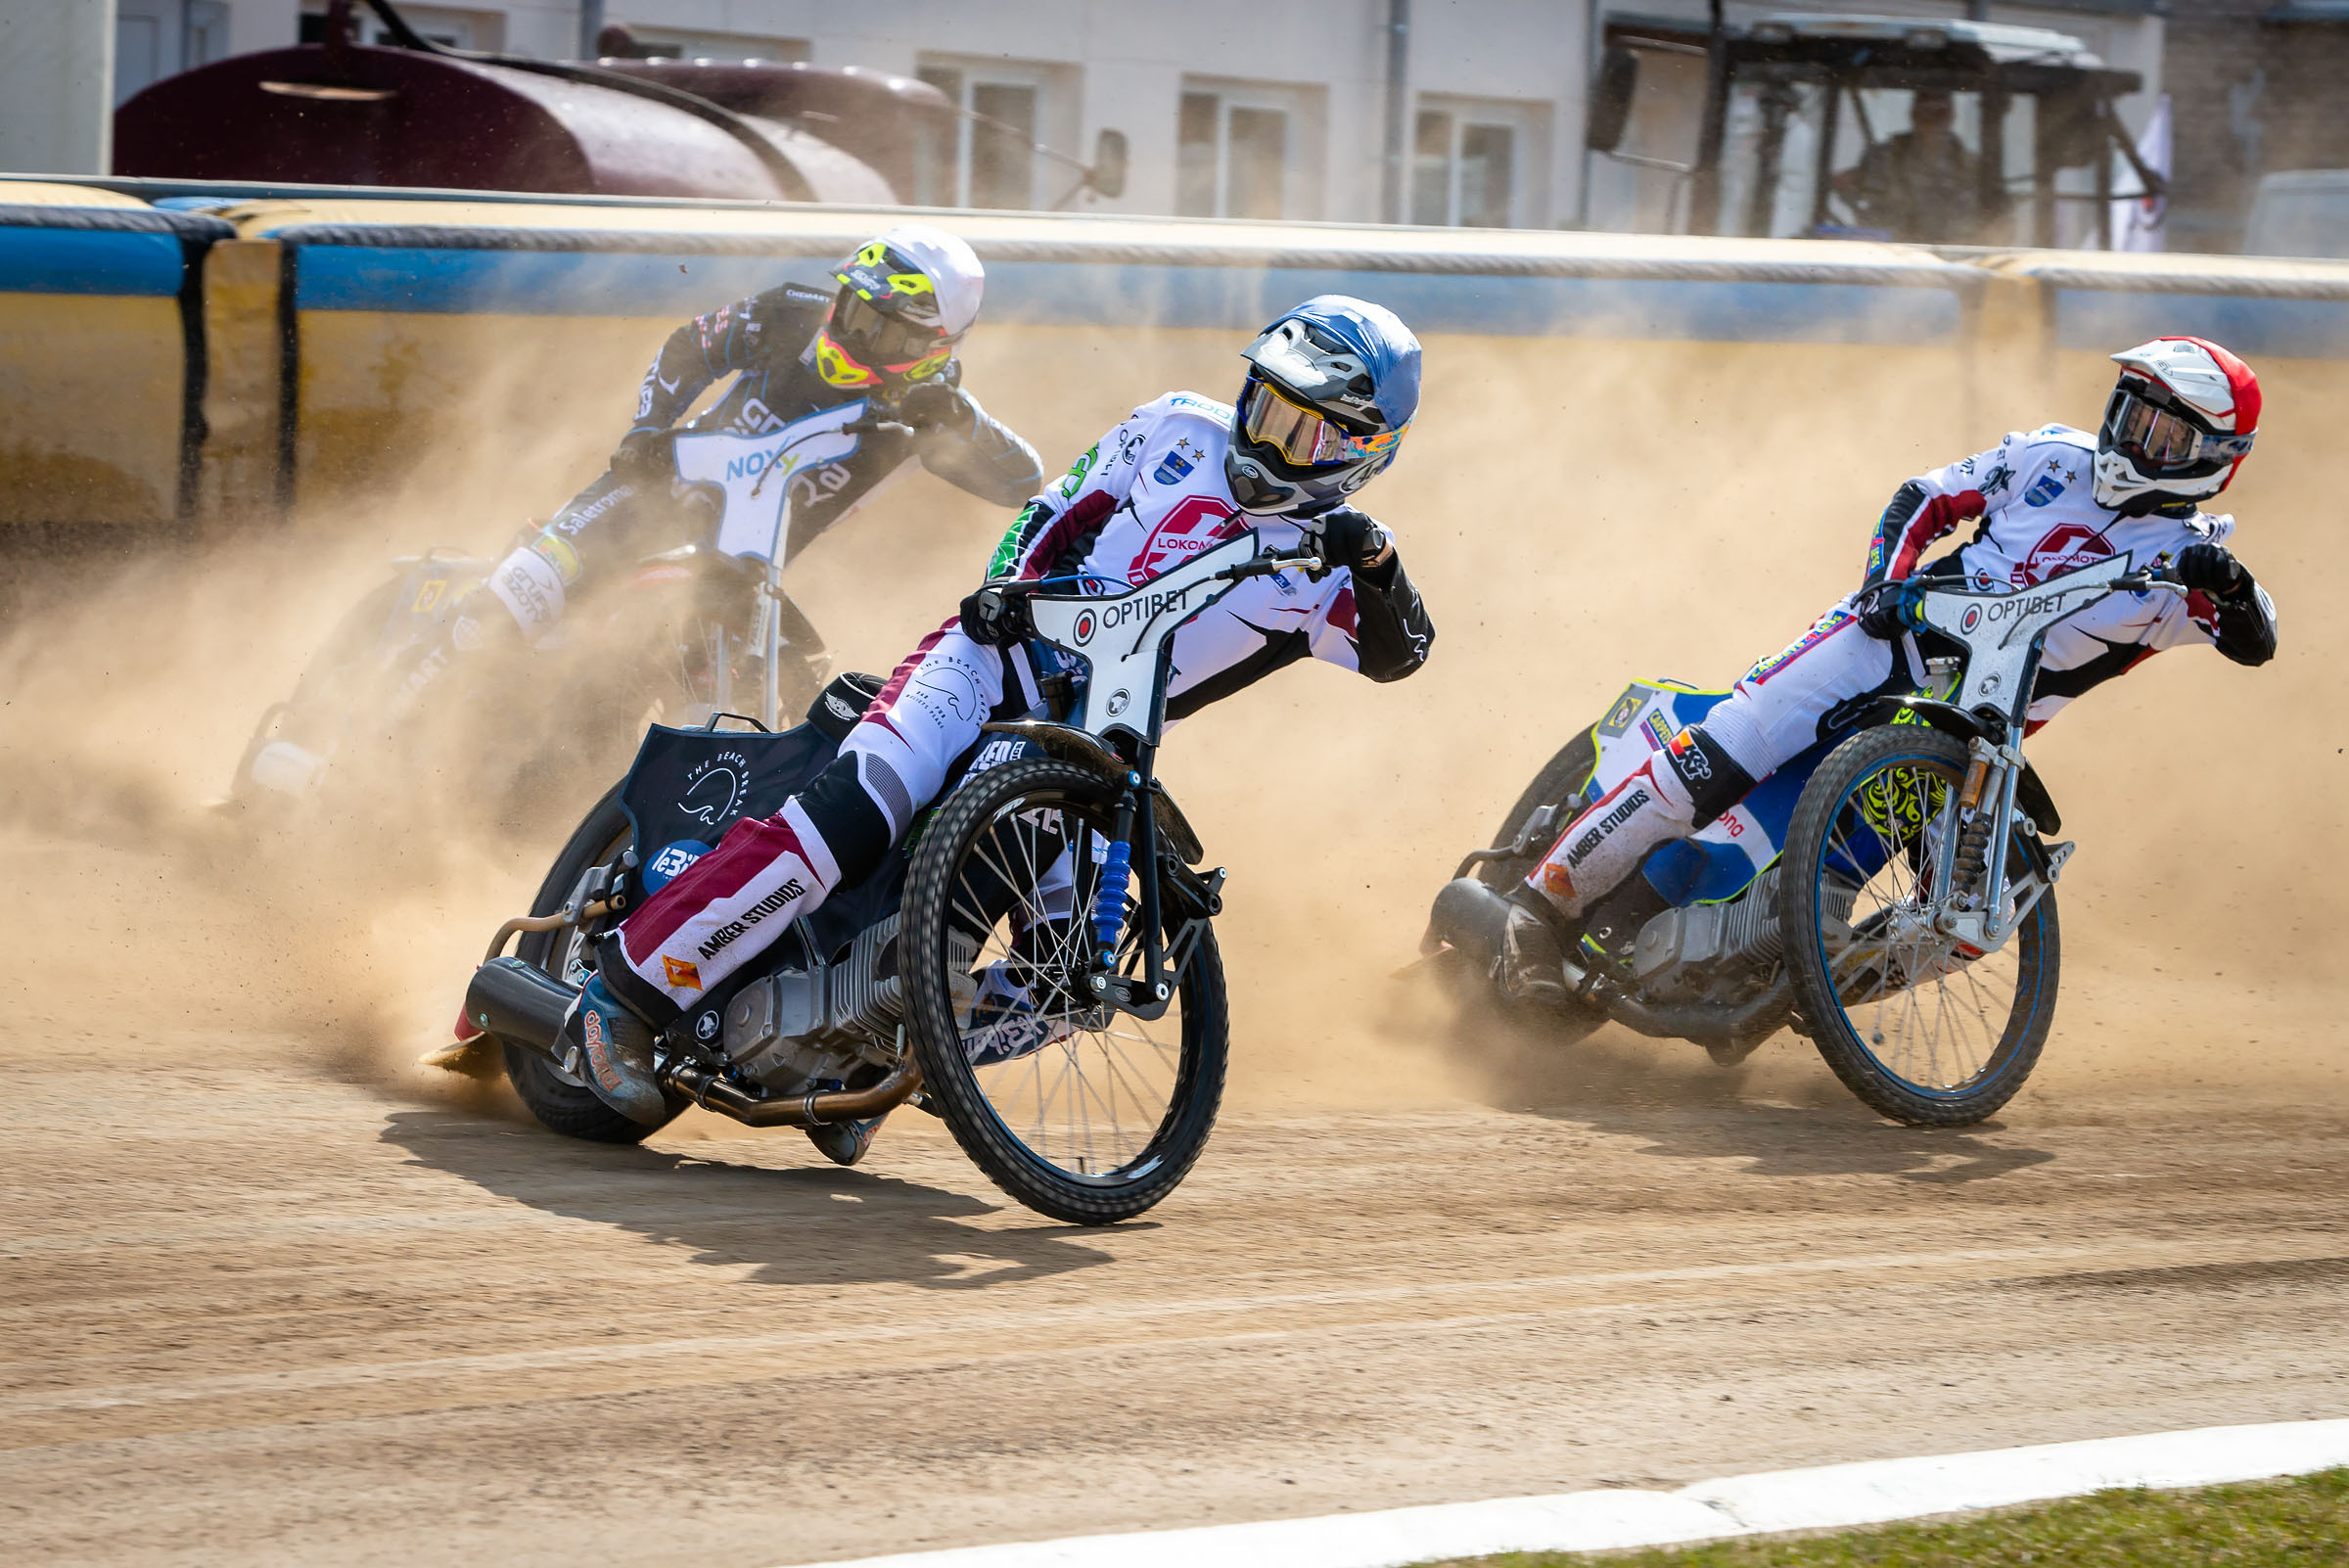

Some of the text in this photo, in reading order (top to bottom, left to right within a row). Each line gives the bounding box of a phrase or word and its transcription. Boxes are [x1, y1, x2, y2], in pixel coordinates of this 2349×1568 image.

[1103, 587, 1190, 629] OPTIBET
[1988, 593, 2067, 623] OPTIBET
[687, 751, 750, 816] THE BEACH BREAK
[1567, 789, 1650, 869] AMBER STUDIOS
[697, 877, 806, 960] AMBER STUDIOS
